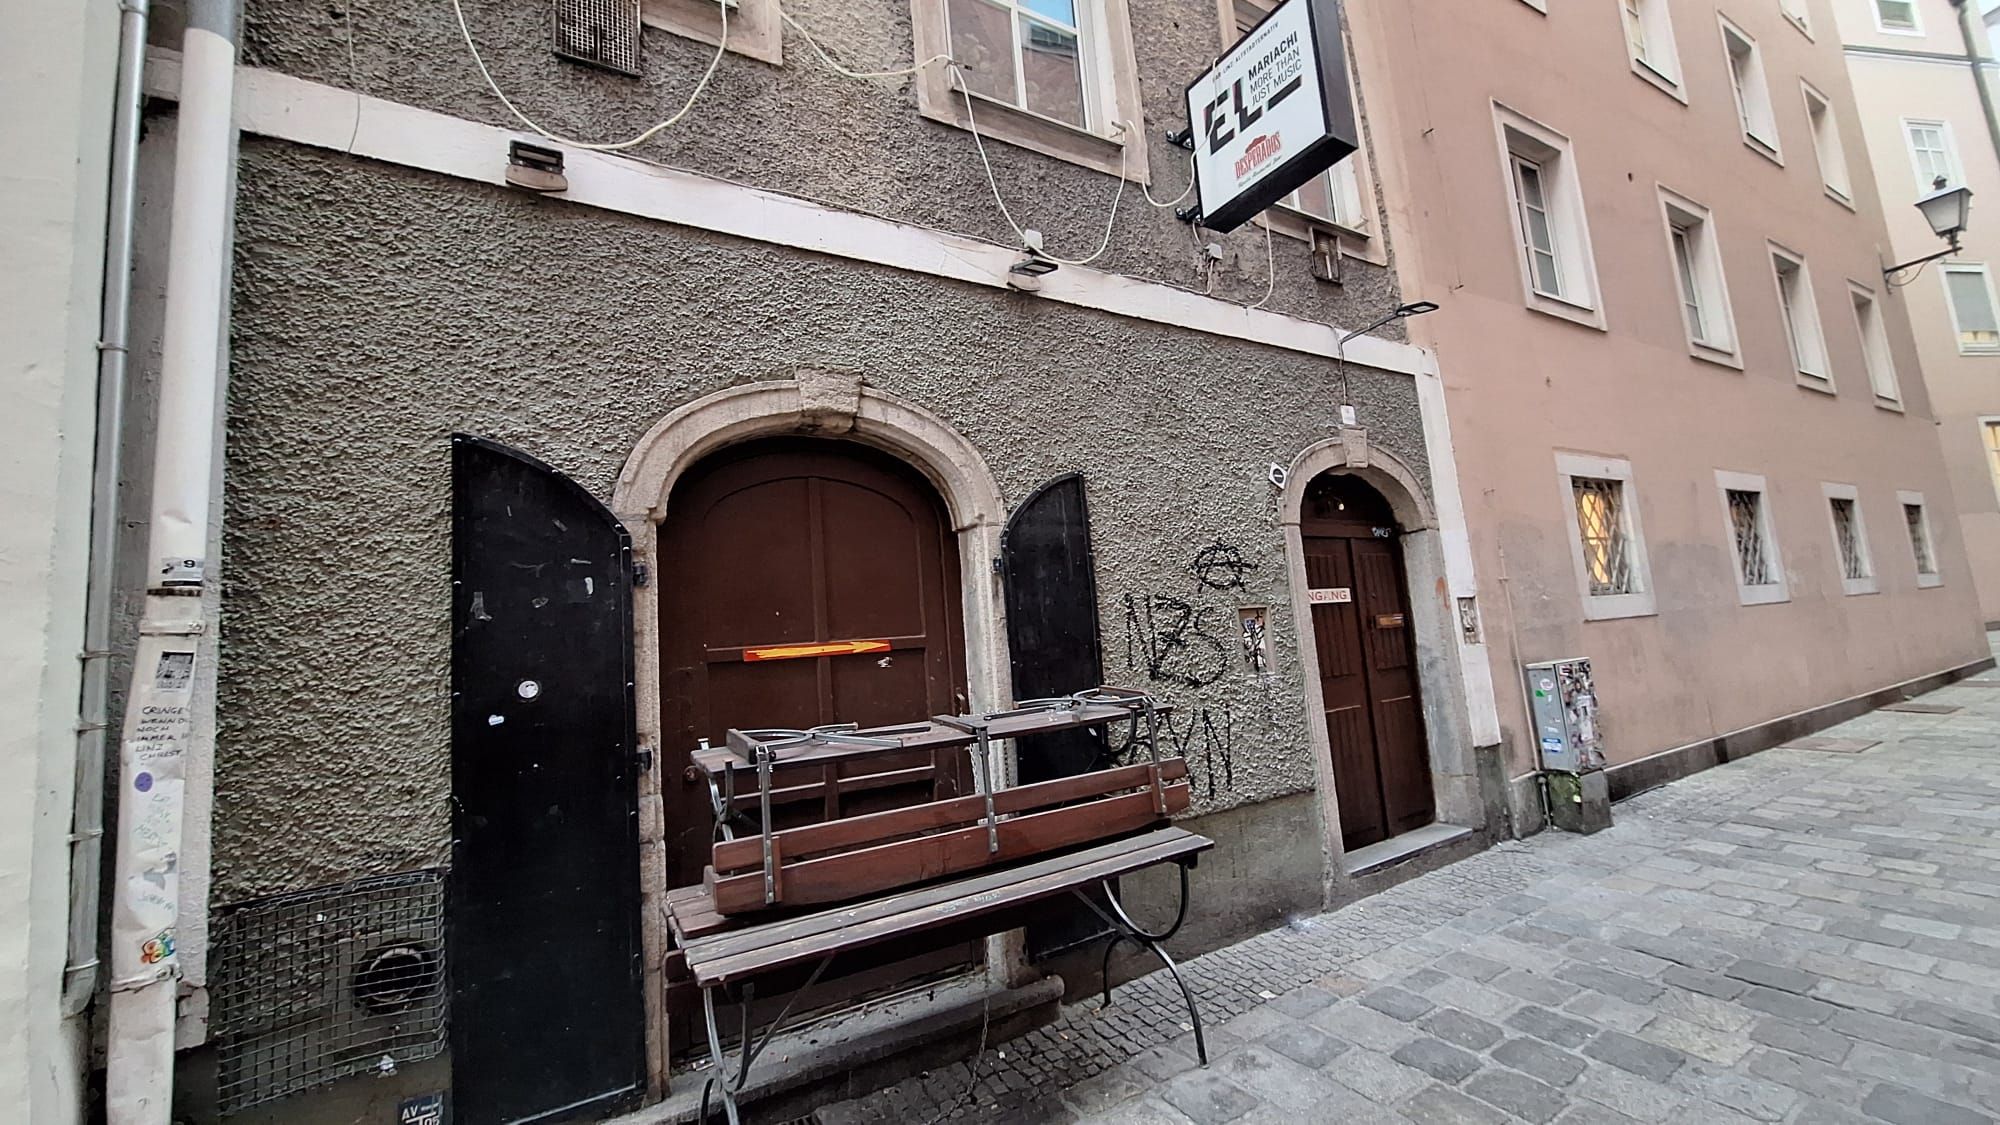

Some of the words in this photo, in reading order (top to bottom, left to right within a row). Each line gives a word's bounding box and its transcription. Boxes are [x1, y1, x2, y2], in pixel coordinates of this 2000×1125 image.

[1248, 31, 1298, 81] MARIACHI
[1249, 66, 1273, 95] MORE
[1275, 46, 1300, 73] THAN
[1251, 83, 1272, 106] JUST
[1273, 59, 1303, 89] MUSIC
[1235, 133, 1281, 179] DESPERADOS
[401, 1104, 418, 1120] AV
